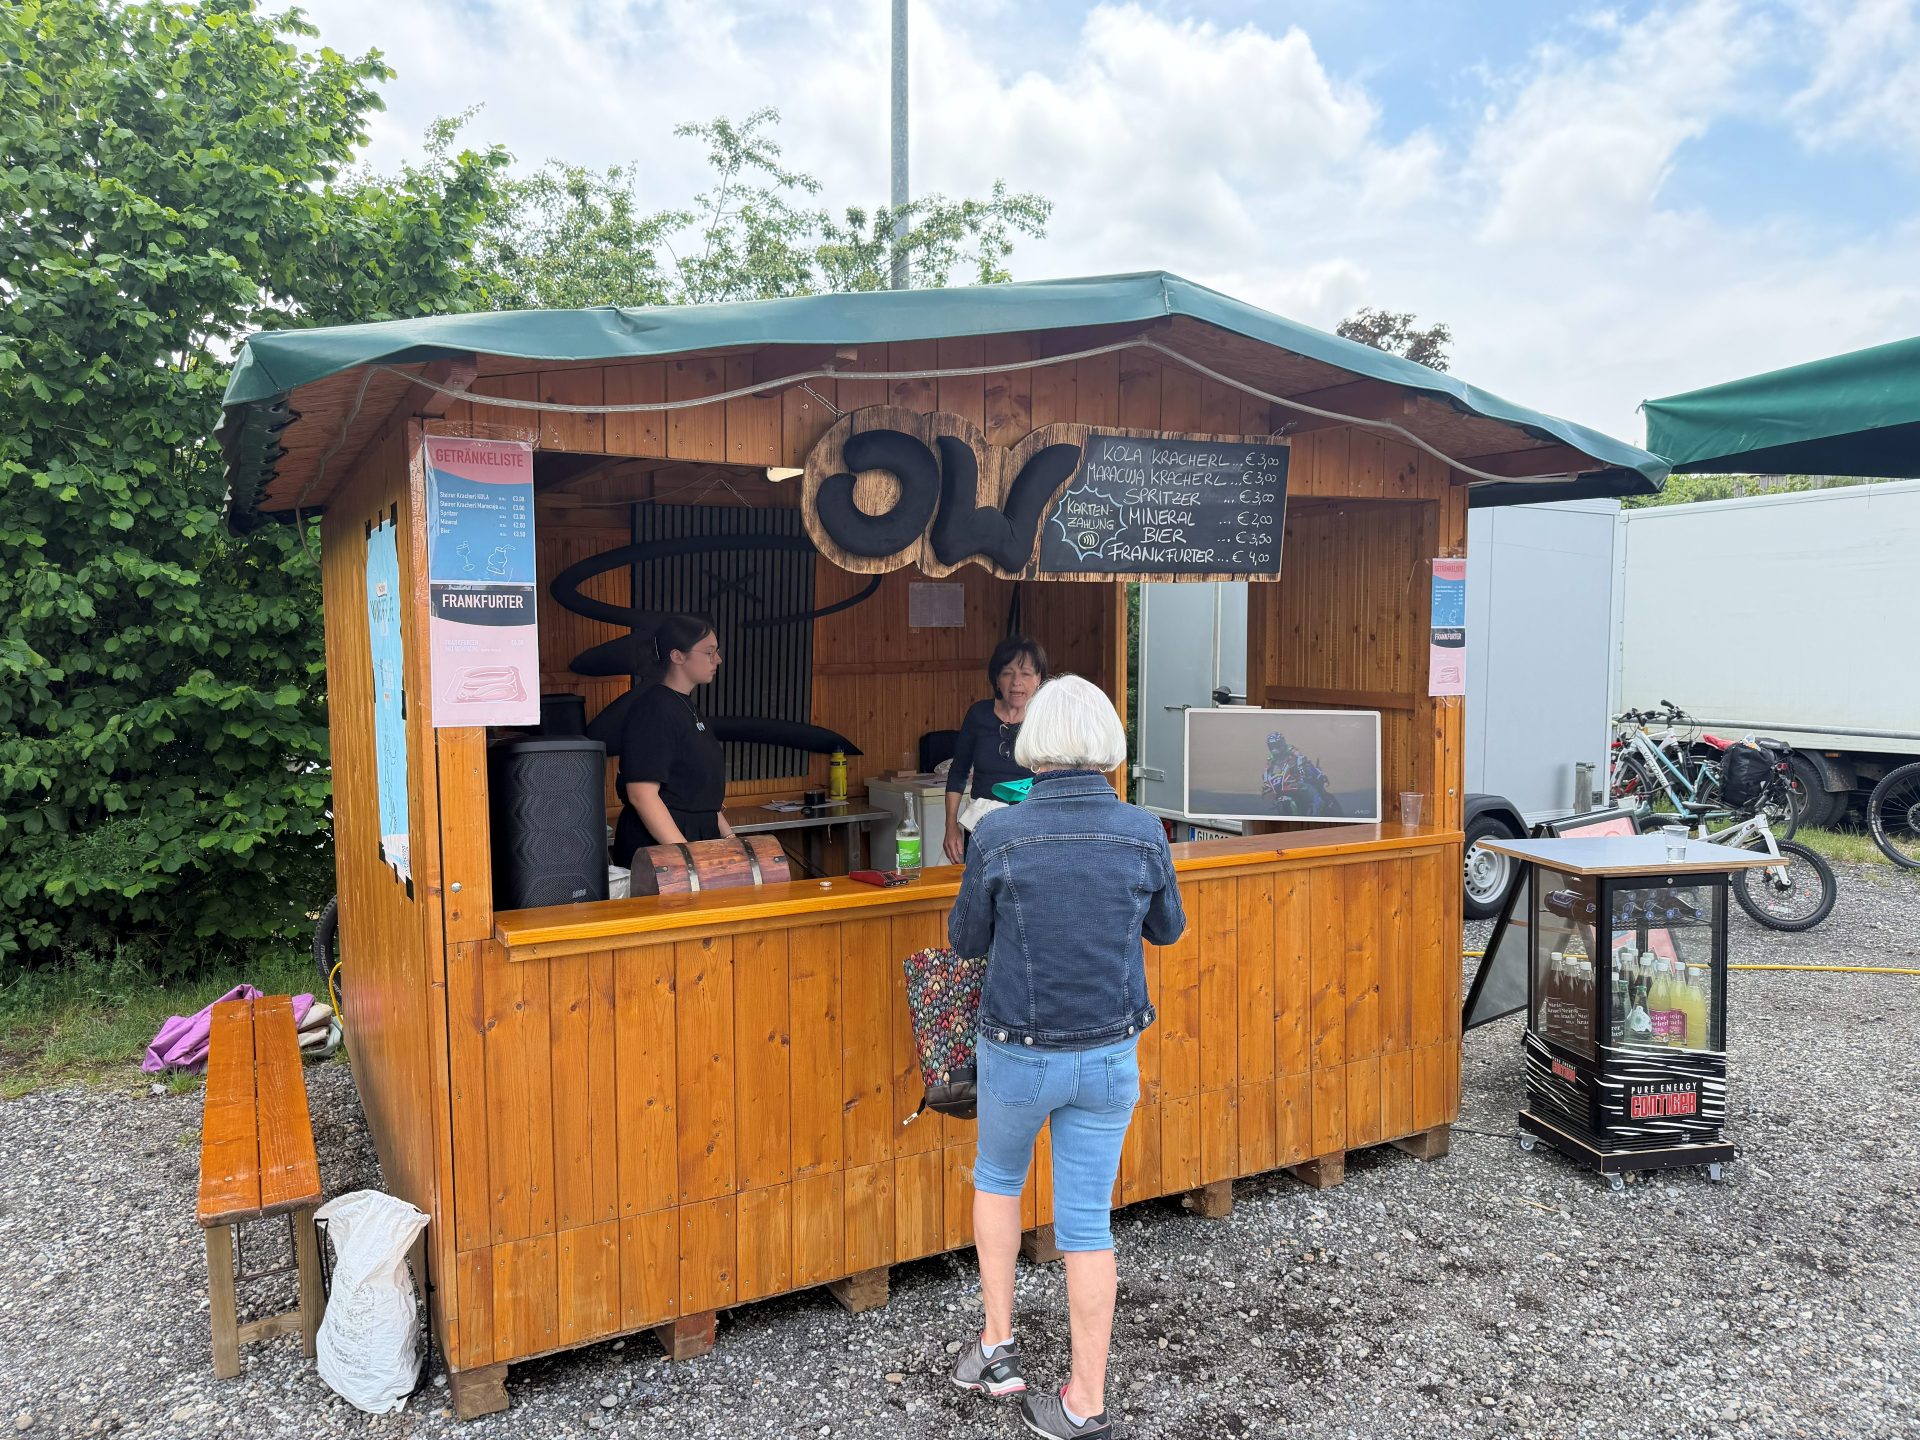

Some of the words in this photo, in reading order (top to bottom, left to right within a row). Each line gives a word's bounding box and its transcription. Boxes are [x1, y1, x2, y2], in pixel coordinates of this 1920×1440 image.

[435, 448, 524, 467] GETRÄNKELISTE
[1103, 441, 1142, 463] KOLA
[1245, 452, 1256, 466] €
[1257, 453, 1279, 469] 3,00
[1087, 462, 1145, 486] MARACUJA
[1242, 470, 1254, 485] €
[1254, 472, 1277, 485] 3,00
[1067, 497, 1114, 517] KARTEN-
[1123, 488, 1201, 506] SPRITZER
[1240, 489, 1252, 504] €
[1251, 491, 1275, 506] 3,00
[1067, 517, 1115, 530] ZAHLUNG
[1129, 506, 1196, 527] MINERAL
[1237, 511, 1250, 526] €
[1251, 513, 1273, 528] 2,00
[1140, 526, 1187, 544] BIER
[1235, 531, 1247, 544] €
[1249, 533, 1272, 546] 3,50
[1107, 542, 1214, 563] FRANKFURTER
[1232, 550, 1244, 563] €
[1248, 551, 1270, 566] 4,00
[442, 594, 524, 609] FRANKFURTER
[1631, 1084, 1655, 1094] PURE
[1660, 1081, 1697, 1093] ENERGY
